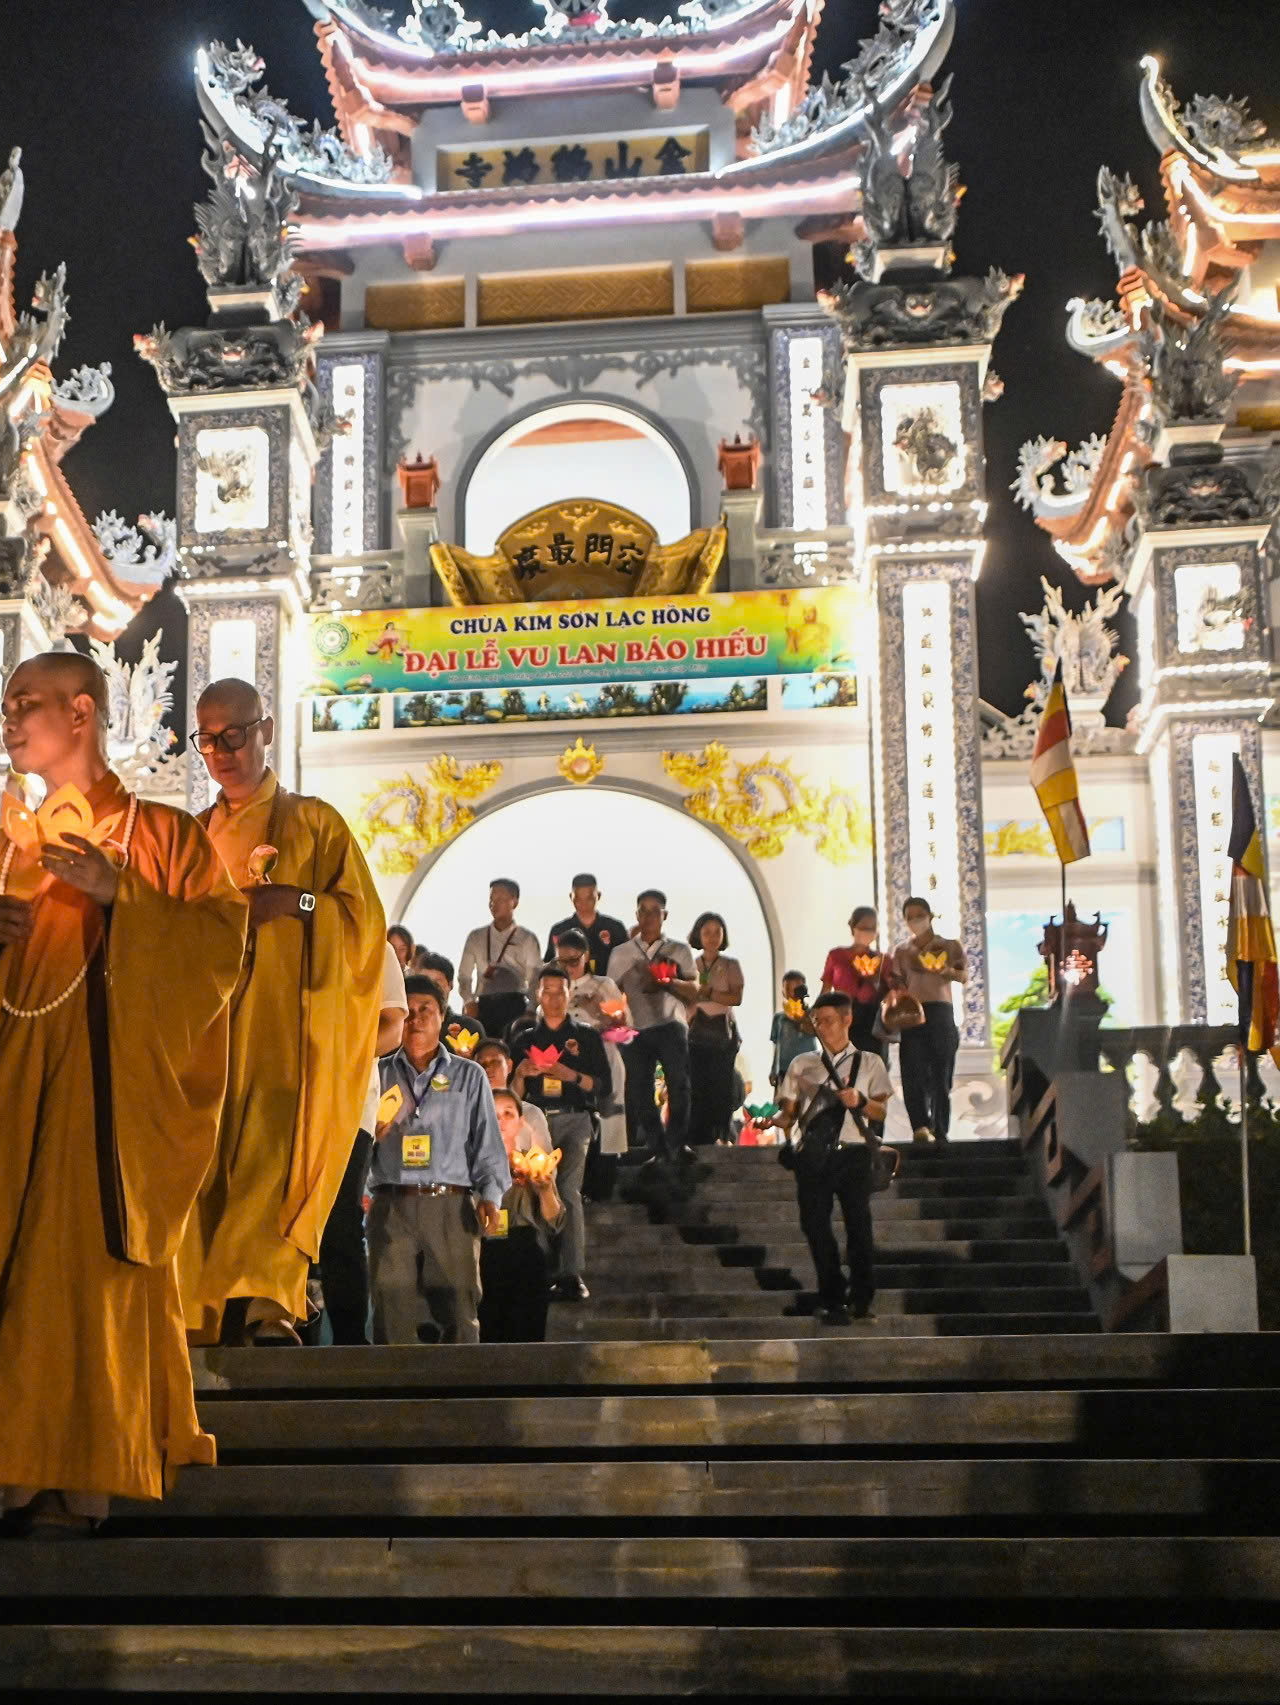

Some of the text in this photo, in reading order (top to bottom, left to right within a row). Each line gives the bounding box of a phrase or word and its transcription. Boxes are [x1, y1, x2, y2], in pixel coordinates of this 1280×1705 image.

[450, 614, 508, 634] CHÙA
[514, 614, 552, 632] KIM
[558, 610, 599, 629] SƠN
[606, 609, 645, 628] LẠC
[405, 650, 458, 677] ĐẠI
[465, 638, 500, 669] LỄ
[507, 646, 549, 667] VU
[558, 642, 618, 665] LAN
[625, 635, 688, 662] BÁO
[695, 628, 767, 658] HIẾU
